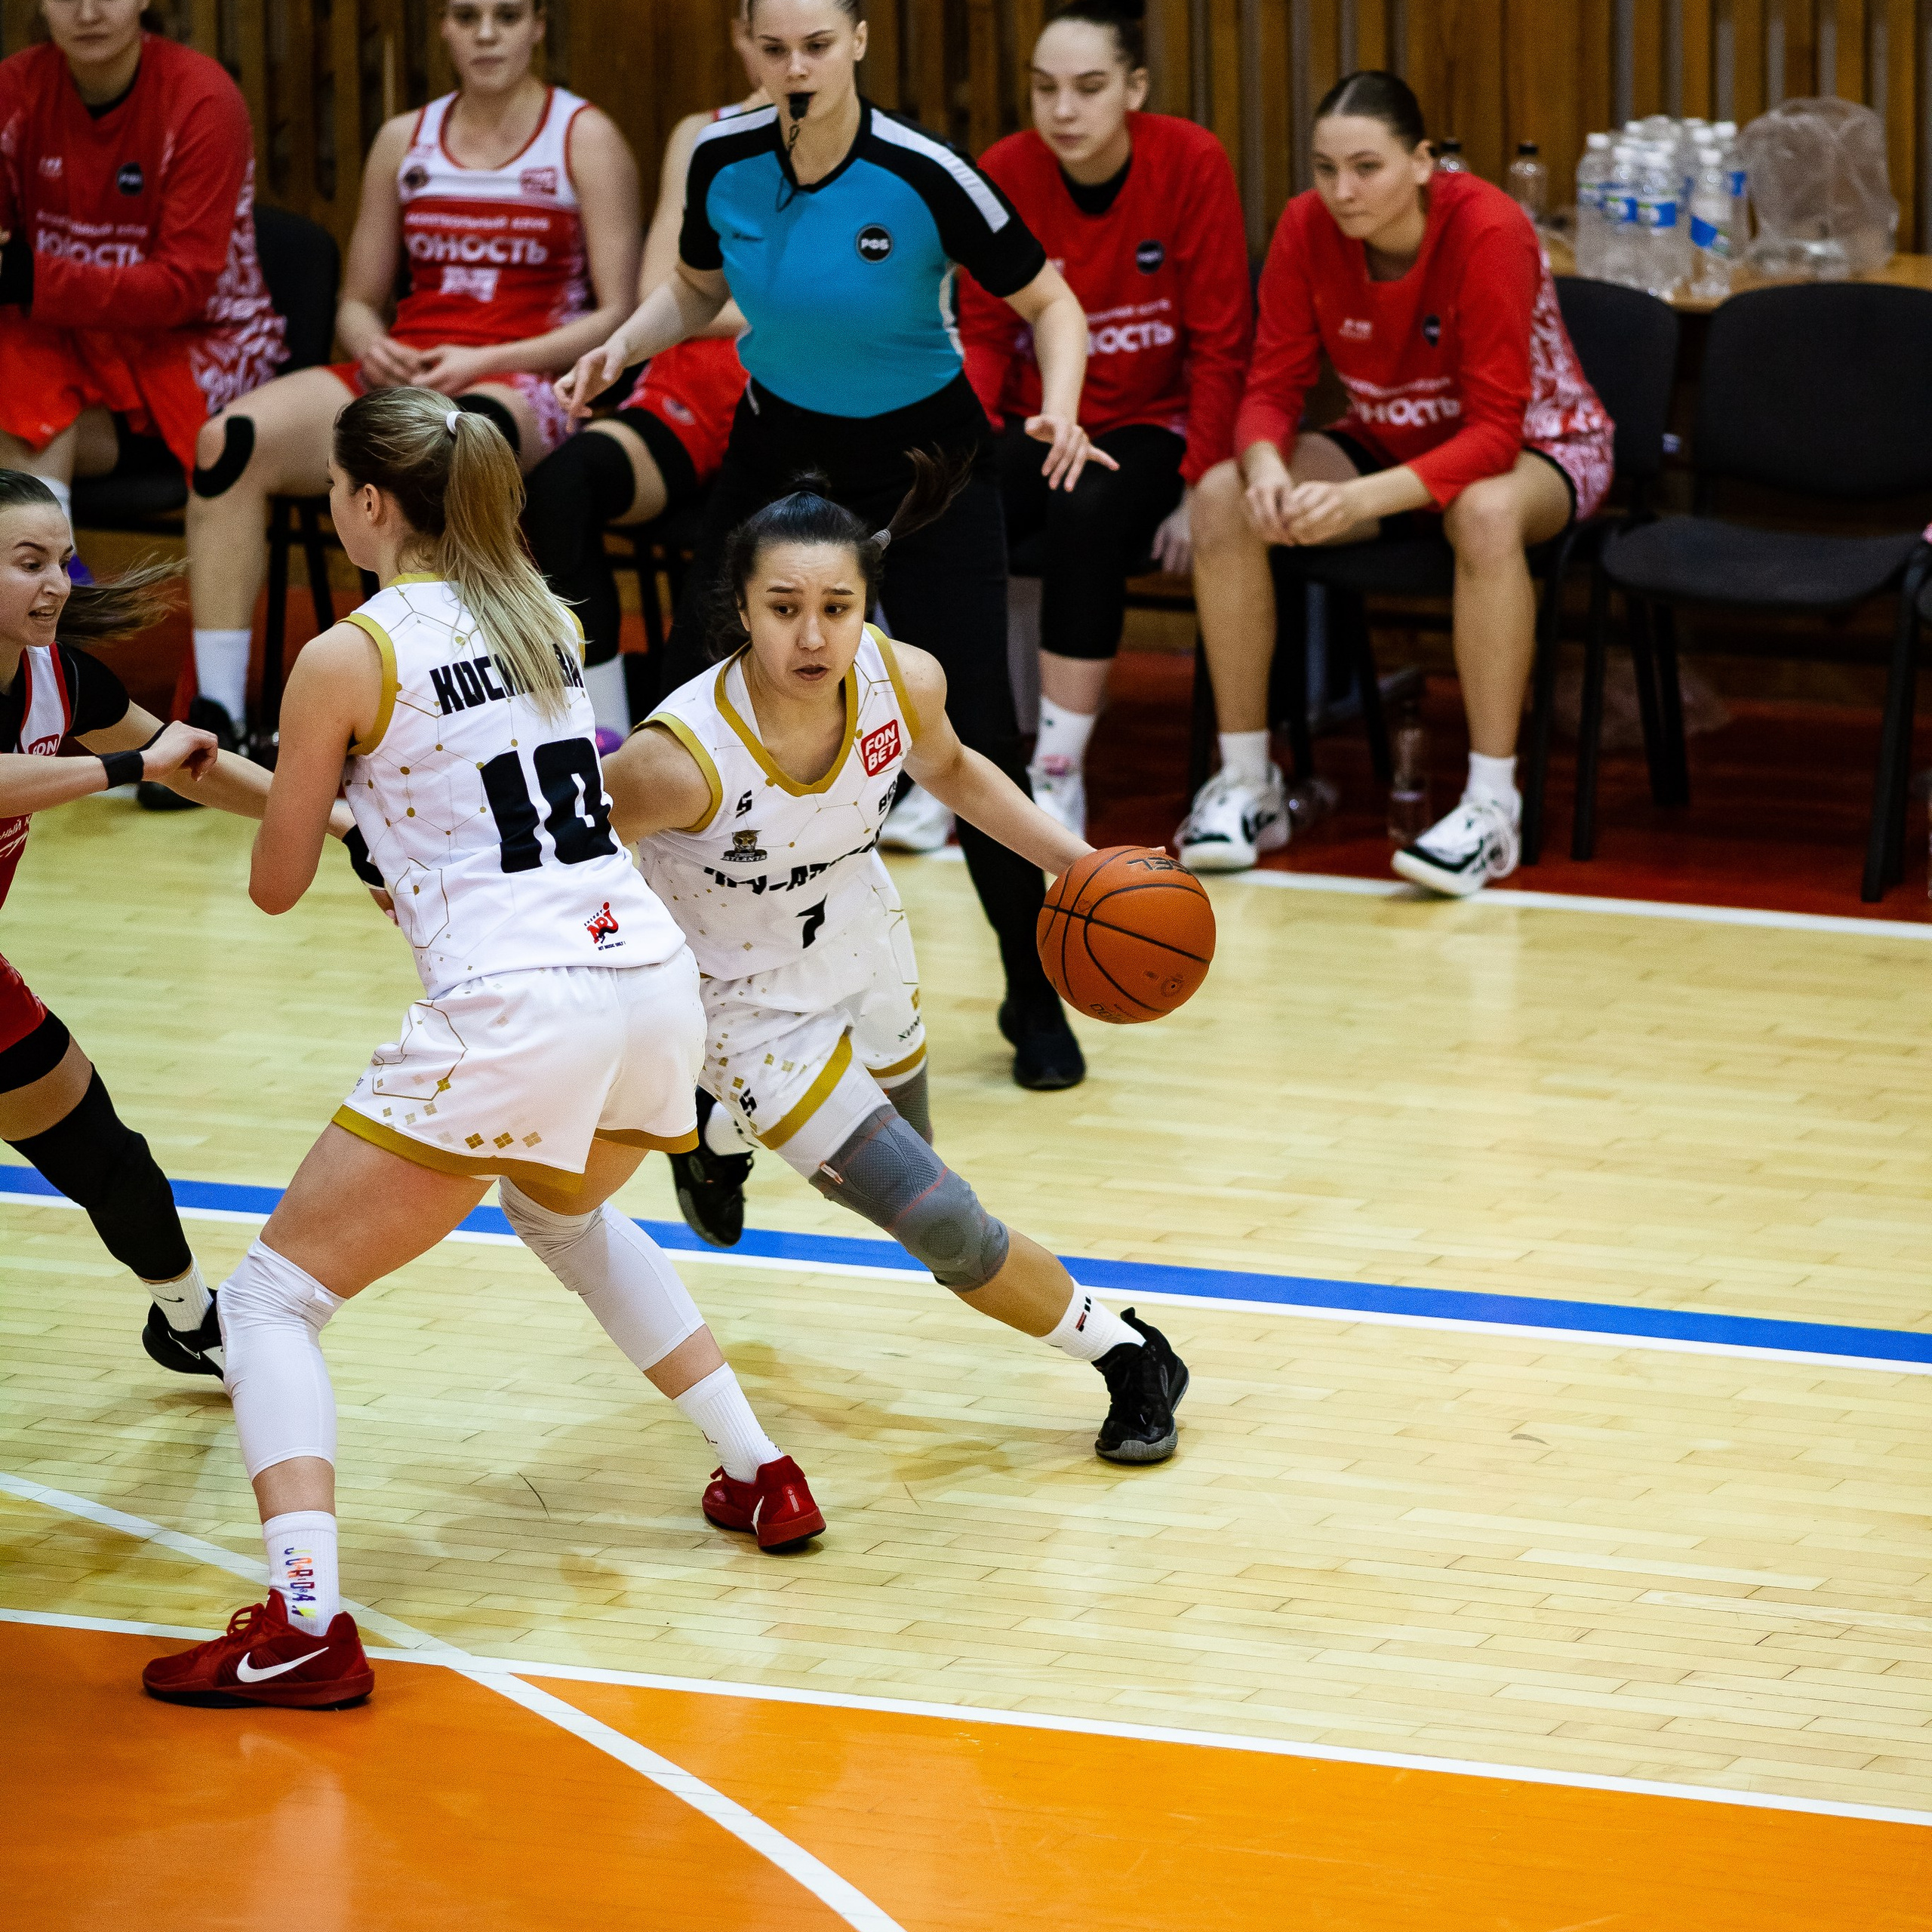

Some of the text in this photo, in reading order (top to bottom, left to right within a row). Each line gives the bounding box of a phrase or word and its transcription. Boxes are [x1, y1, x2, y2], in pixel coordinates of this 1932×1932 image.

[865, 724, 896, 756] FON
[868, 738, 898, 771] BET
[480, 737, 619, 874] 10
[795, 894, 828, 949] 7
